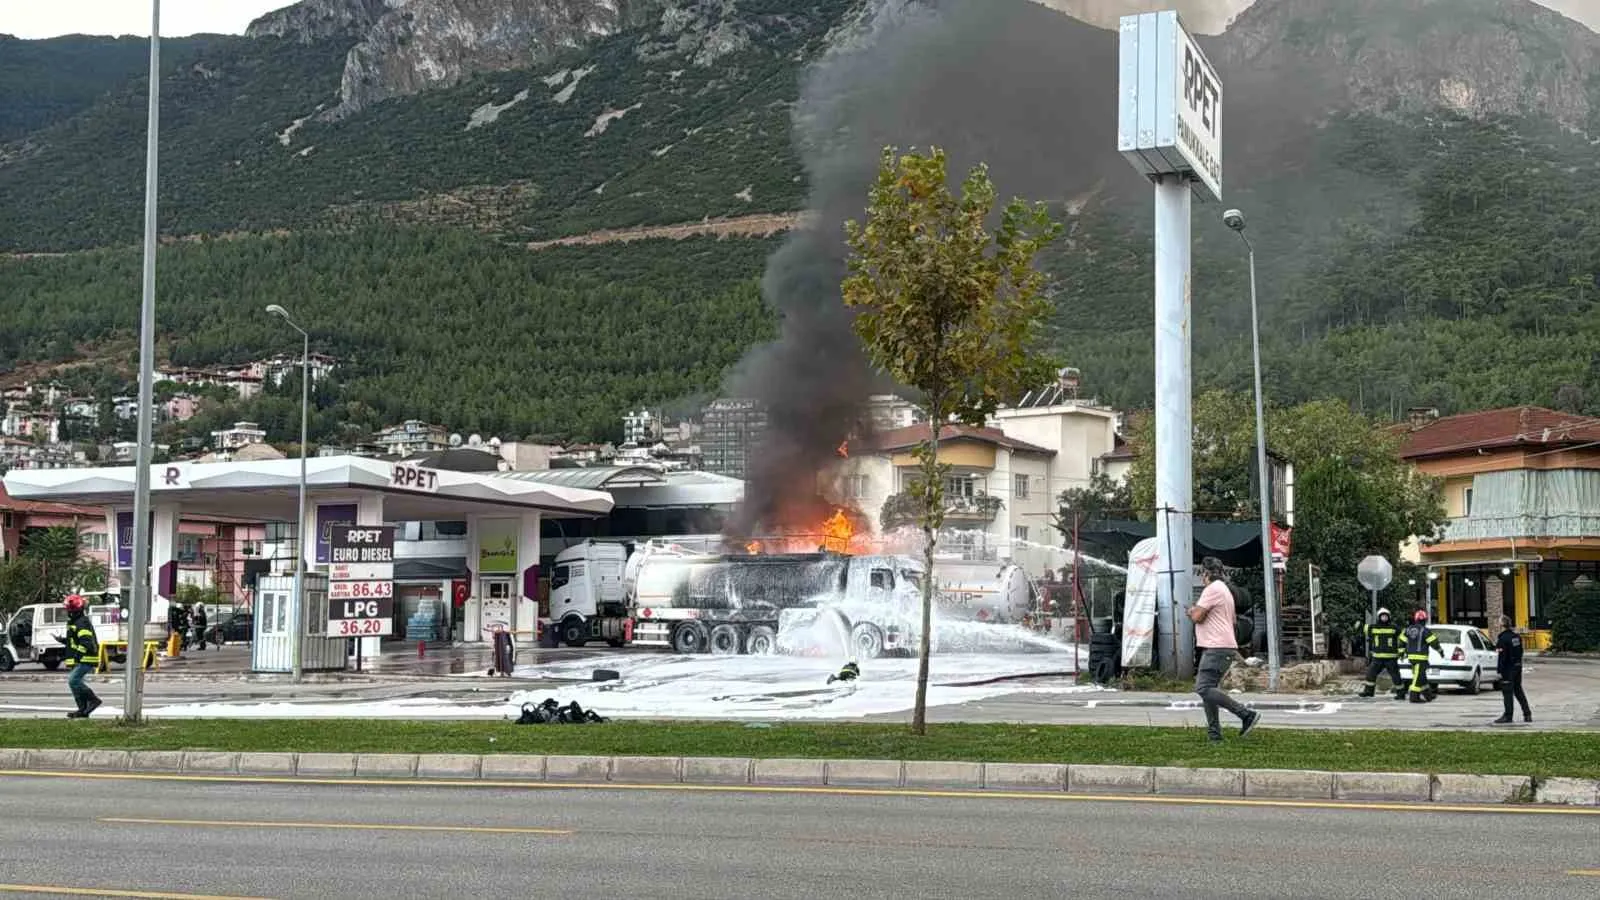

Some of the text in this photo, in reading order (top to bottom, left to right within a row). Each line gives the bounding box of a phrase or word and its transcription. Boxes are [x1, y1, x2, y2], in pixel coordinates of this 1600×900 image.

[1183, 44, 1218, 139] RPET
[162, 467, 181, 485] R
[393, 466, 437, 489] RPET
[346, 530, 382, 543] RPET
[333, 548, 392, 561] EURO DIESEL
[352, 583, 392, 597] 86.43
[343, 601, 379, 618] LPG
[340, 620, 381, 635] 36.20
